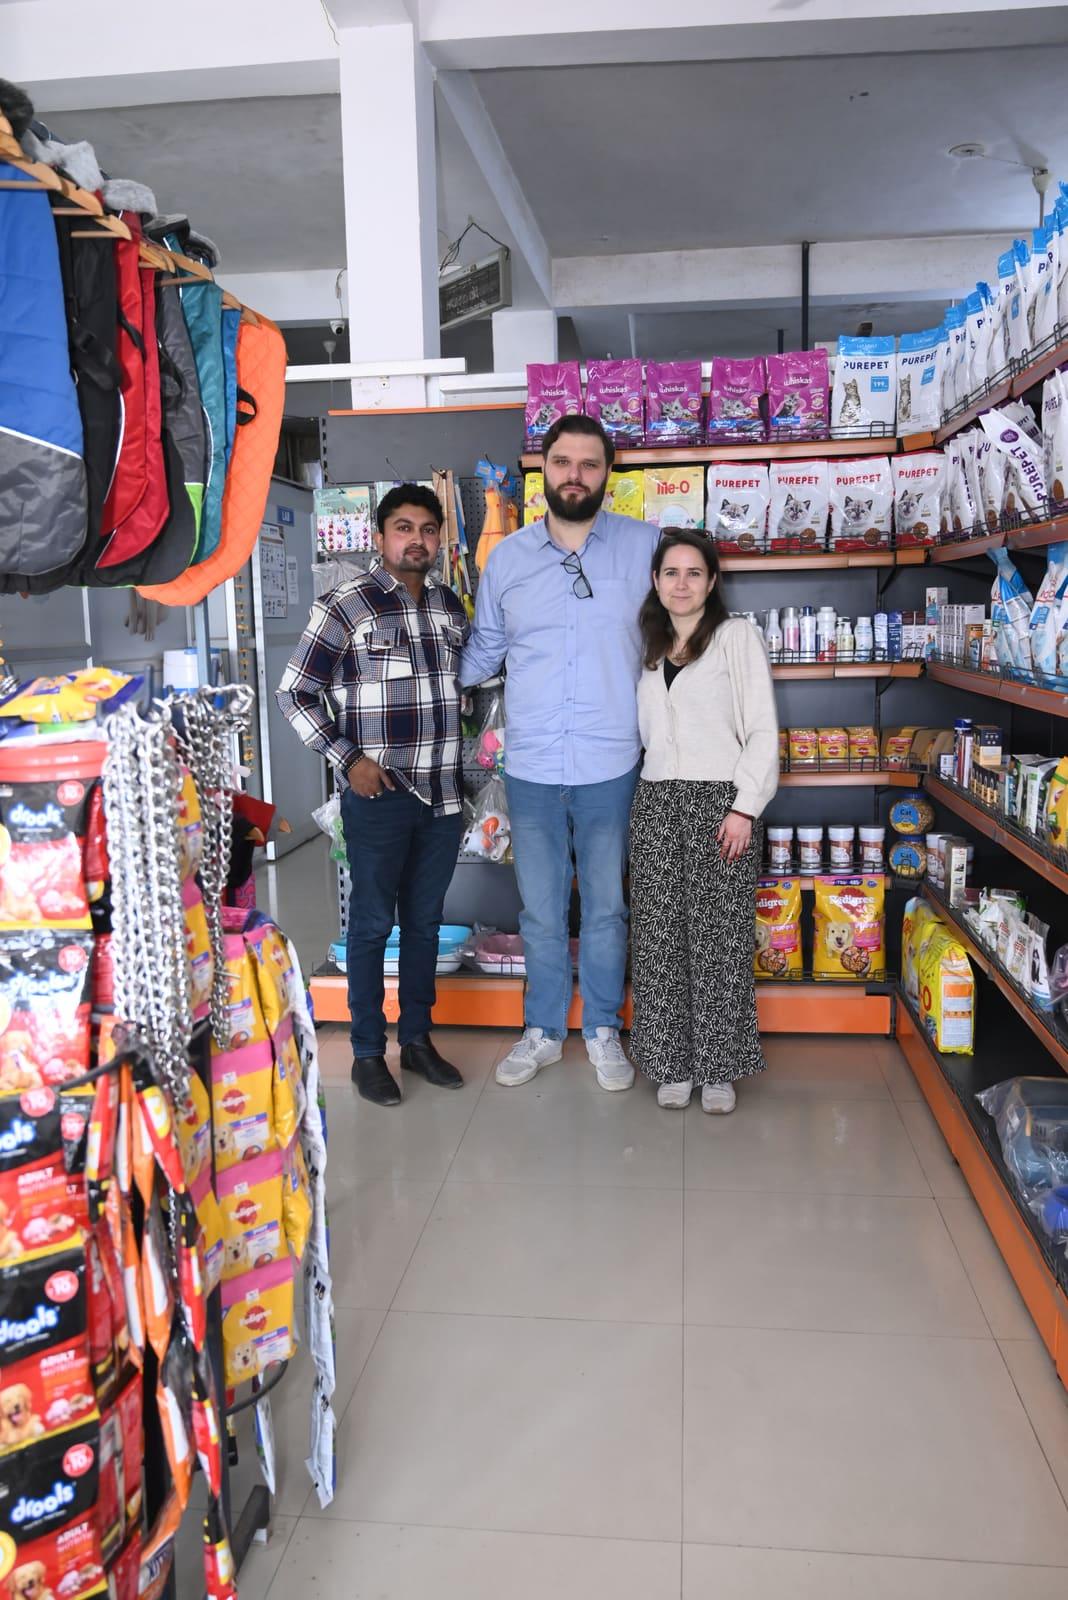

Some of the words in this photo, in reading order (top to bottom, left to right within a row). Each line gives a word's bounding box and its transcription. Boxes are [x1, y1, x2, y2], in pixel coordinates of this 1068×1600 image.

[902, 350, 938, 365] PUREPET
[843, 361, 889, 370] PUREPET
[784, 376, 812, 386] whiskas
[600, 386, 628, 394] whiskas
[659, 385, 688, 394] whiskas
[898, 468, 939, 479] PUREPET
[1009, 446, 1048, 501] PUREPET
[715, 480, 760, 488] PUREPET
[777, 476, 819, 485] PUREPET
[836, 474, 881, 486] PUREPET
[10, 803, 62, 825] drools
[756, 898, 789, 909] digree
[829, 895, 875, 909] Pedigree
[0, 1117, 35, 1150] ols
[0, 1304, 58, 1343] drools
[11, 1481, 74, 1522] drools
